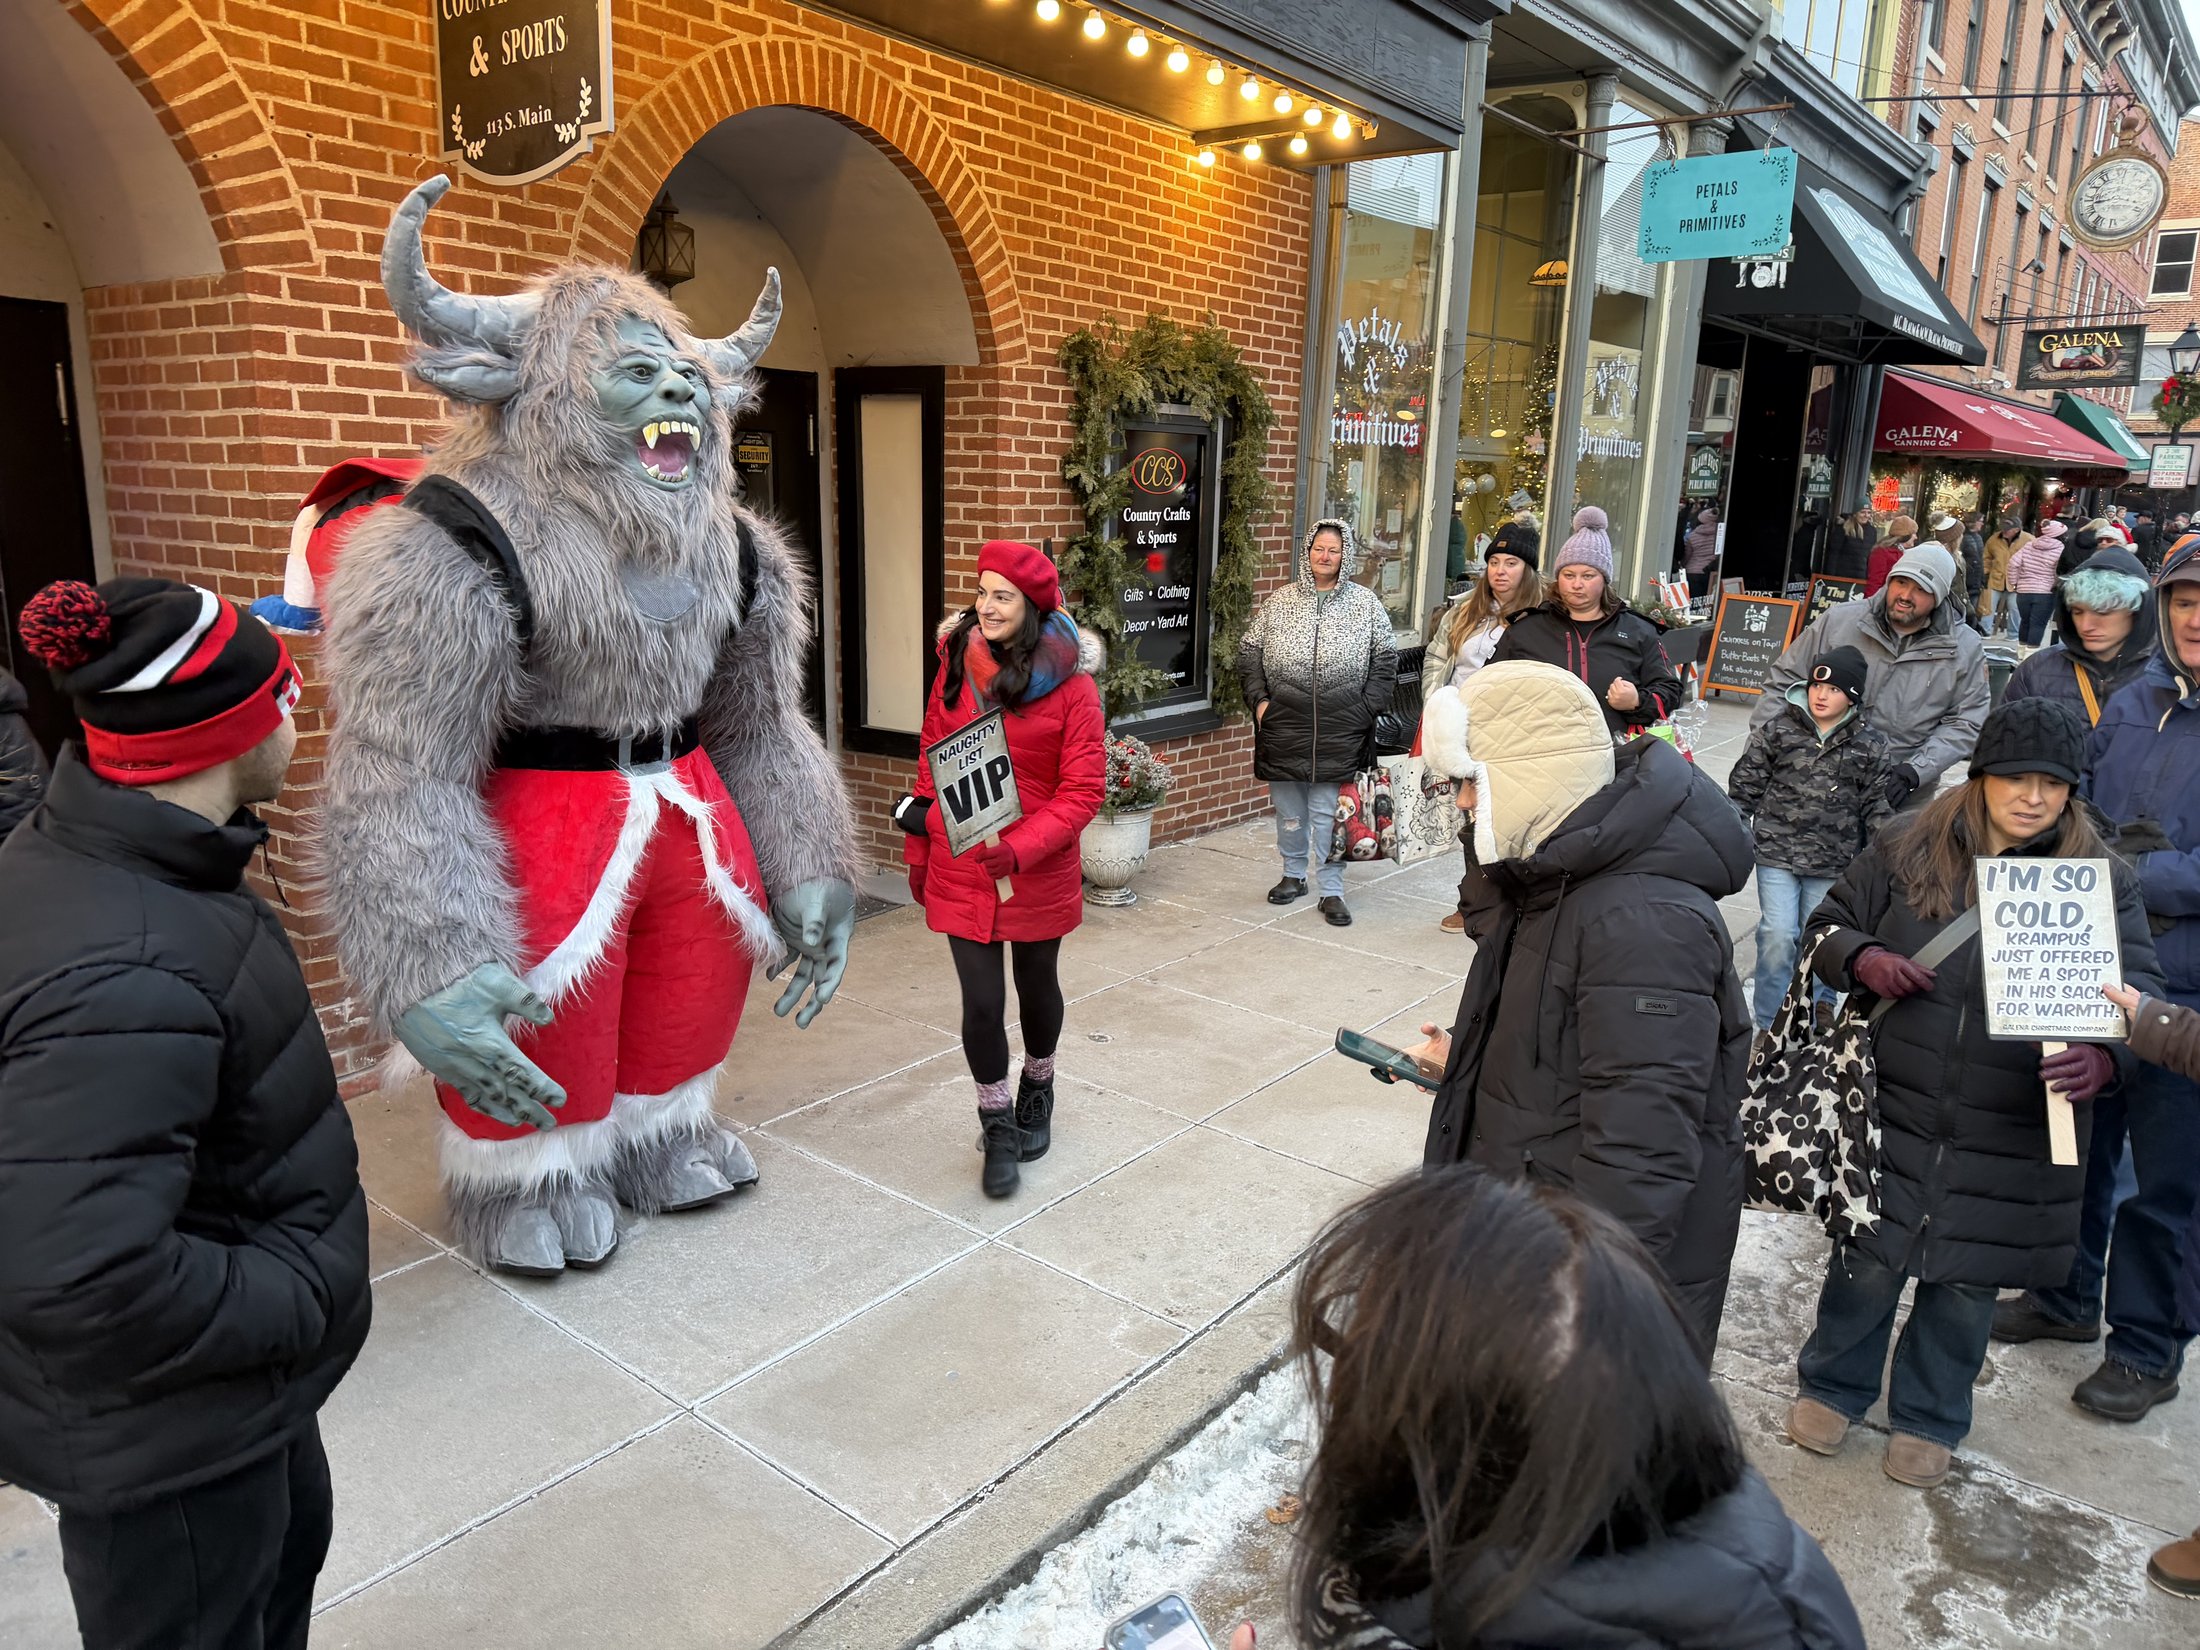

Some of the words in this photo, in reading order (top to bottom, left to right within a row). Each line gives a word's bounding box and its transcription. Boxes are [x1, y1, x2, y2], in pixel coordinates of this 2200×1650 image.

[469, 35, 489, 77] &
[501, 15, 566, 66] SPORTS
[486, 119, 503, 137] 113
[505, 111, 516, 131] S.
[518, 105, 552, 128] Main
[1696, 180, 1738, 199] PETALS
[1710, 199, 1718, 213] &
[1679, 214, 1746, 233] PRIMITIVES
[1337, 306, 1409, 371] Petals
[2039, 332, 2124, 353] GALENA
[1363, 357, 1380, 394] &
[1330, 408, 1420, 447] rimitives
[1885, 426, 1958, 442] GALENA
[1577, 426, 1642, 461] Primitives
[740, 451, 769, 460] SECURITY
[1141, 455, 1177, 487] CCS
[1123, 507, 1161, 526] Country
[1163, 507, 1190, 521] Crafts
[1137, 531, 1146, 545] &
[1147, 530, 1177, 548] Sports
[1124, 588, 1144, 602] Gifts
[1157, 585, 1190, 600] Clothing
[1123, 618, 1149, 633] Decor
[1157, 615, 1175, 630] Yard
[1175, 615, 1188, 627] Art
[1722, 663, 1734, 672] Ask
[1736, 666, 1752, 674] about
[939, 720, 997, 765] NAUGHTY
[959, 746, 984, 770] LIST
[942, 754, 1010, 825] VIP
[1986, 861, 2042, 892] I'M
[2052, 864, 2097, 892] SO
[1994, 901, 2094, 932] COLD,
[2006, 932, 2091, 946] KRAMPUS
[1991, 950, 2034, 963] JUST
[2040, 951, 2114, 964] OFFERED
[2007, 967, 2032, 980] ME
[2039, 968, 2050, 981] A
[2056, 968, 2102, 982] SPOT
[2006, 985, 2023, 998] IN
[2029, 985, 2056, 999] HIS
[2062, 986, 2105, 1000] SACK
[1996, 1002, 2029, 1016] FOR
[2035, 1003, 2120, 1018] WARMTH.
[2031, 1024, 2072, 1032] CHRISTMAS
[2073, 1025, 2108, 1033] COMPANY
